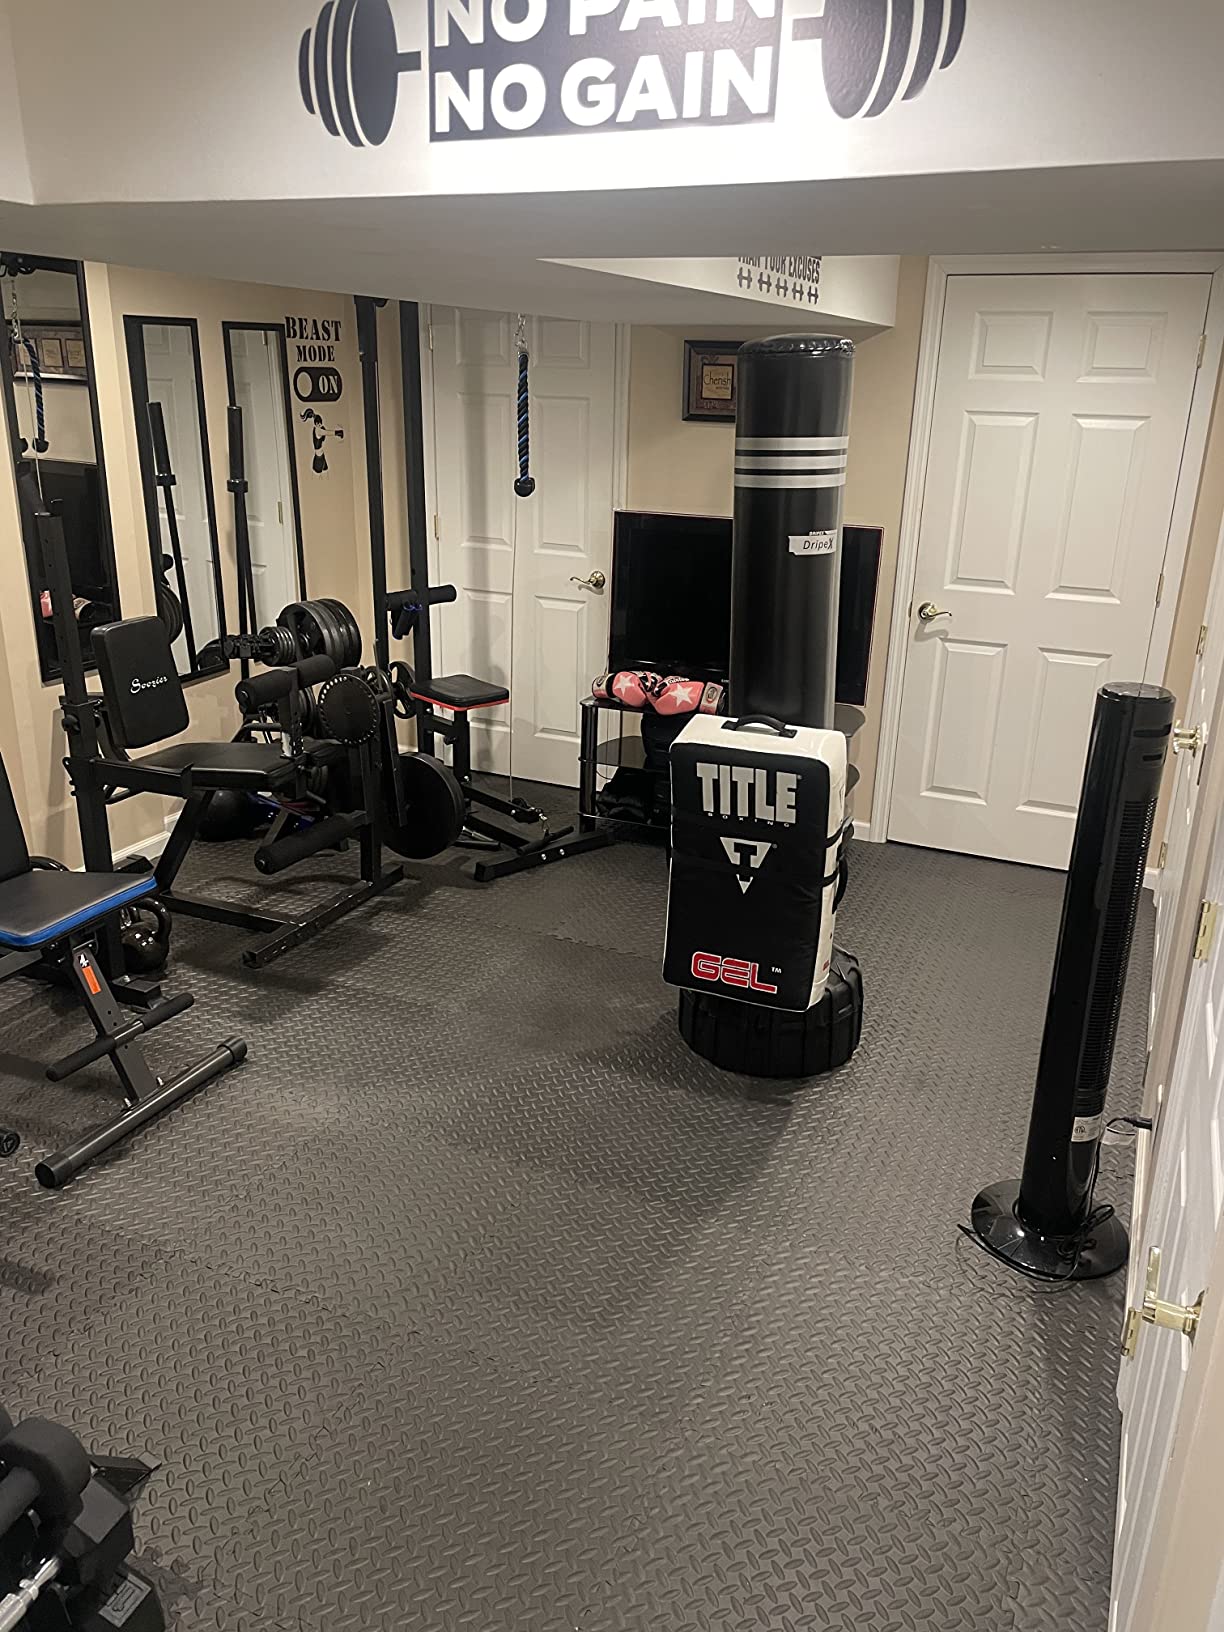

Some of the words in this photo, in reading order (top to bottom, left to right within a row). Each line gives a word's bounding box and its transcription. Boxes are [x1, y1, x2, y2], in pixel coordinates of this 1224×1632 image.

[434, 0, 547, 47] NO
[434, 64, 546, 133] NO
[560, 46, 774, 127] GAIN
[285, 316, 341, 342] BEAST
[296, 345, 335, 362] MODE
[318, 375, 338, 394] ON
[696, 762, 797, 824] TITLE
[691, 951, 778, 994] GEL
